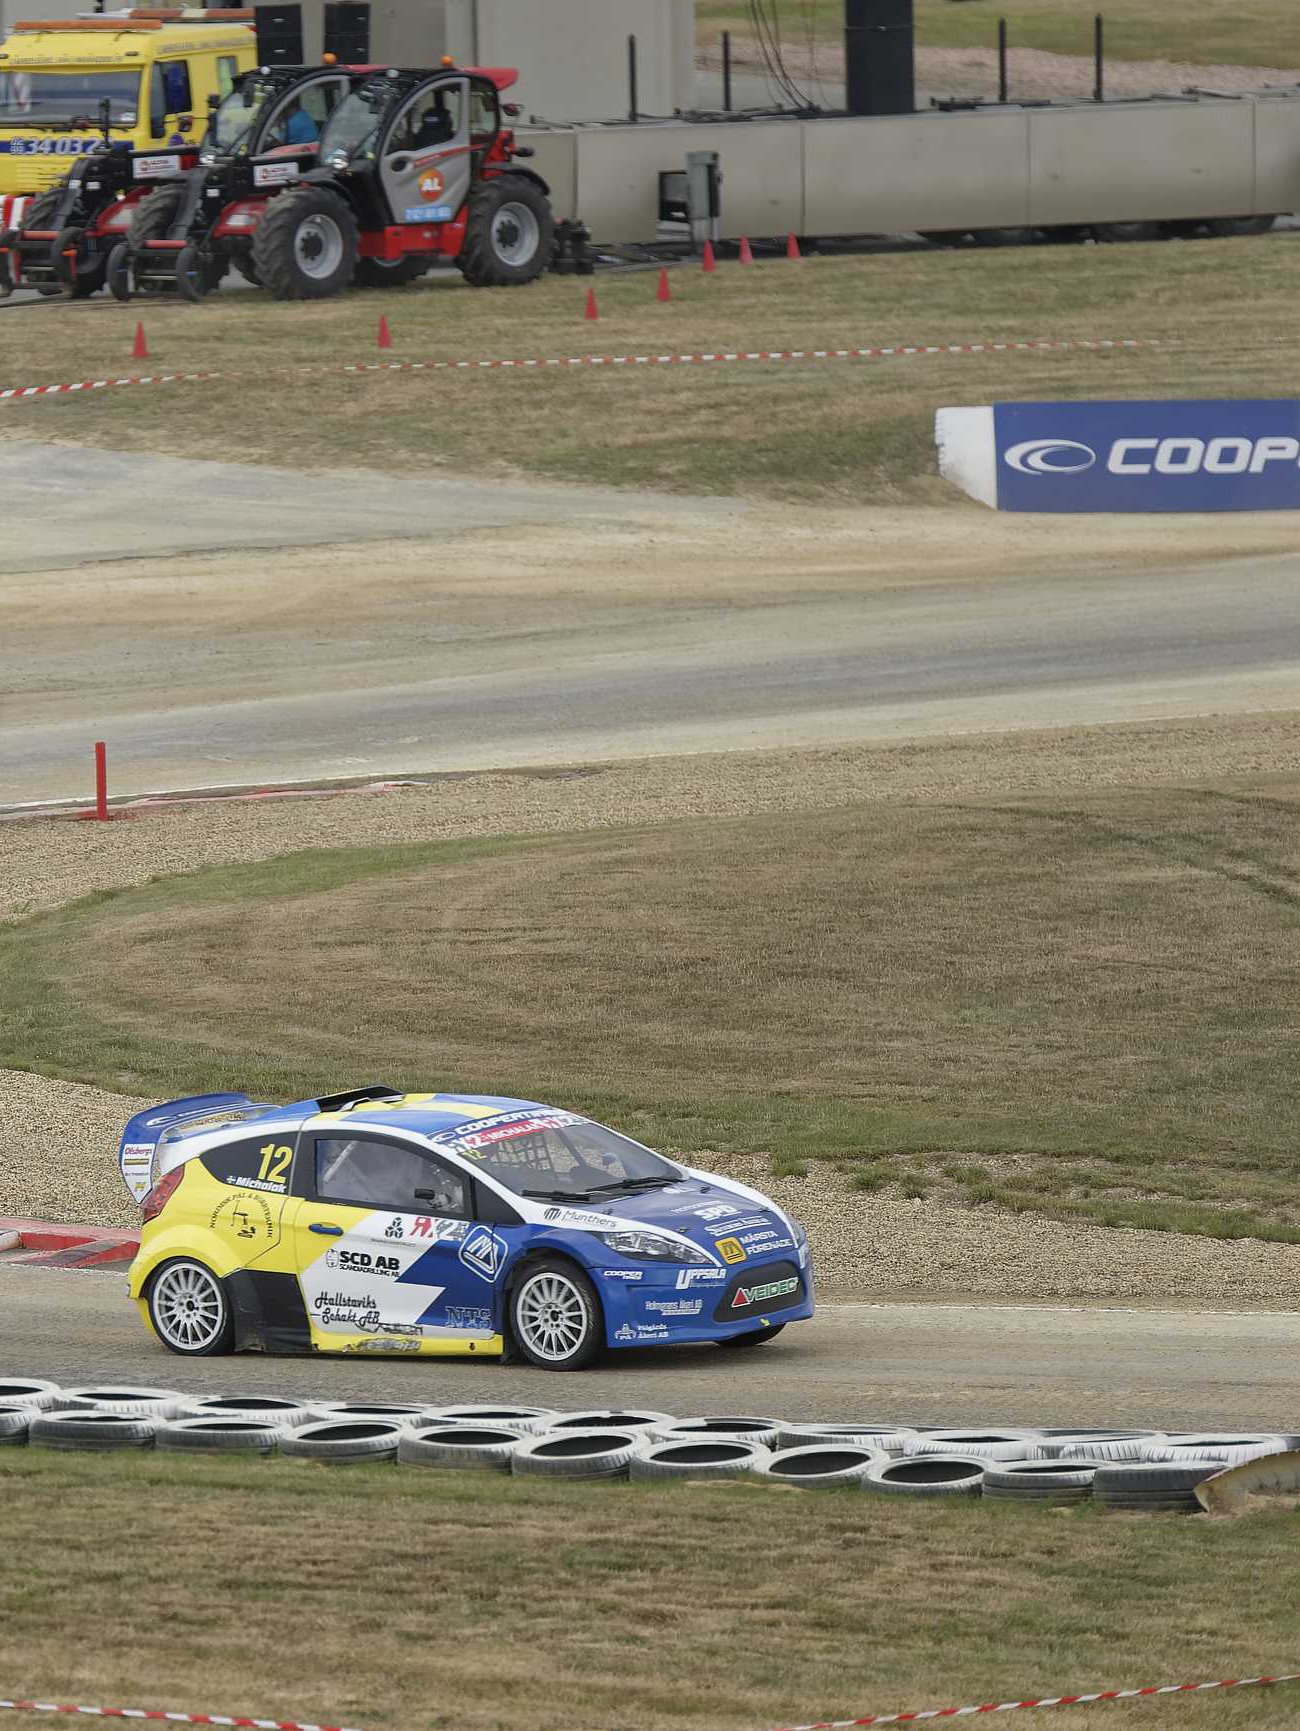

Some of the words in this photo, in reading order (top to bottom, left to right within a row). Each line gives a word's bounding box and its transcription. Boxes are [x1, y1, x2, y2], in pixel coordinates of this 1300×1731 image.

[254, 1143, 294, 1184] 12
[236, 1175, 287, 1194] Michalak
[339, 1251, 371, 1266] SCD
[376, 1256, 400, 1271] AB
[604, 1270, 643, 1278] COOPER
[676, 1269, 727, 1290] UPPSALA
[744, 1276, 797, 1302] VEIDEC
